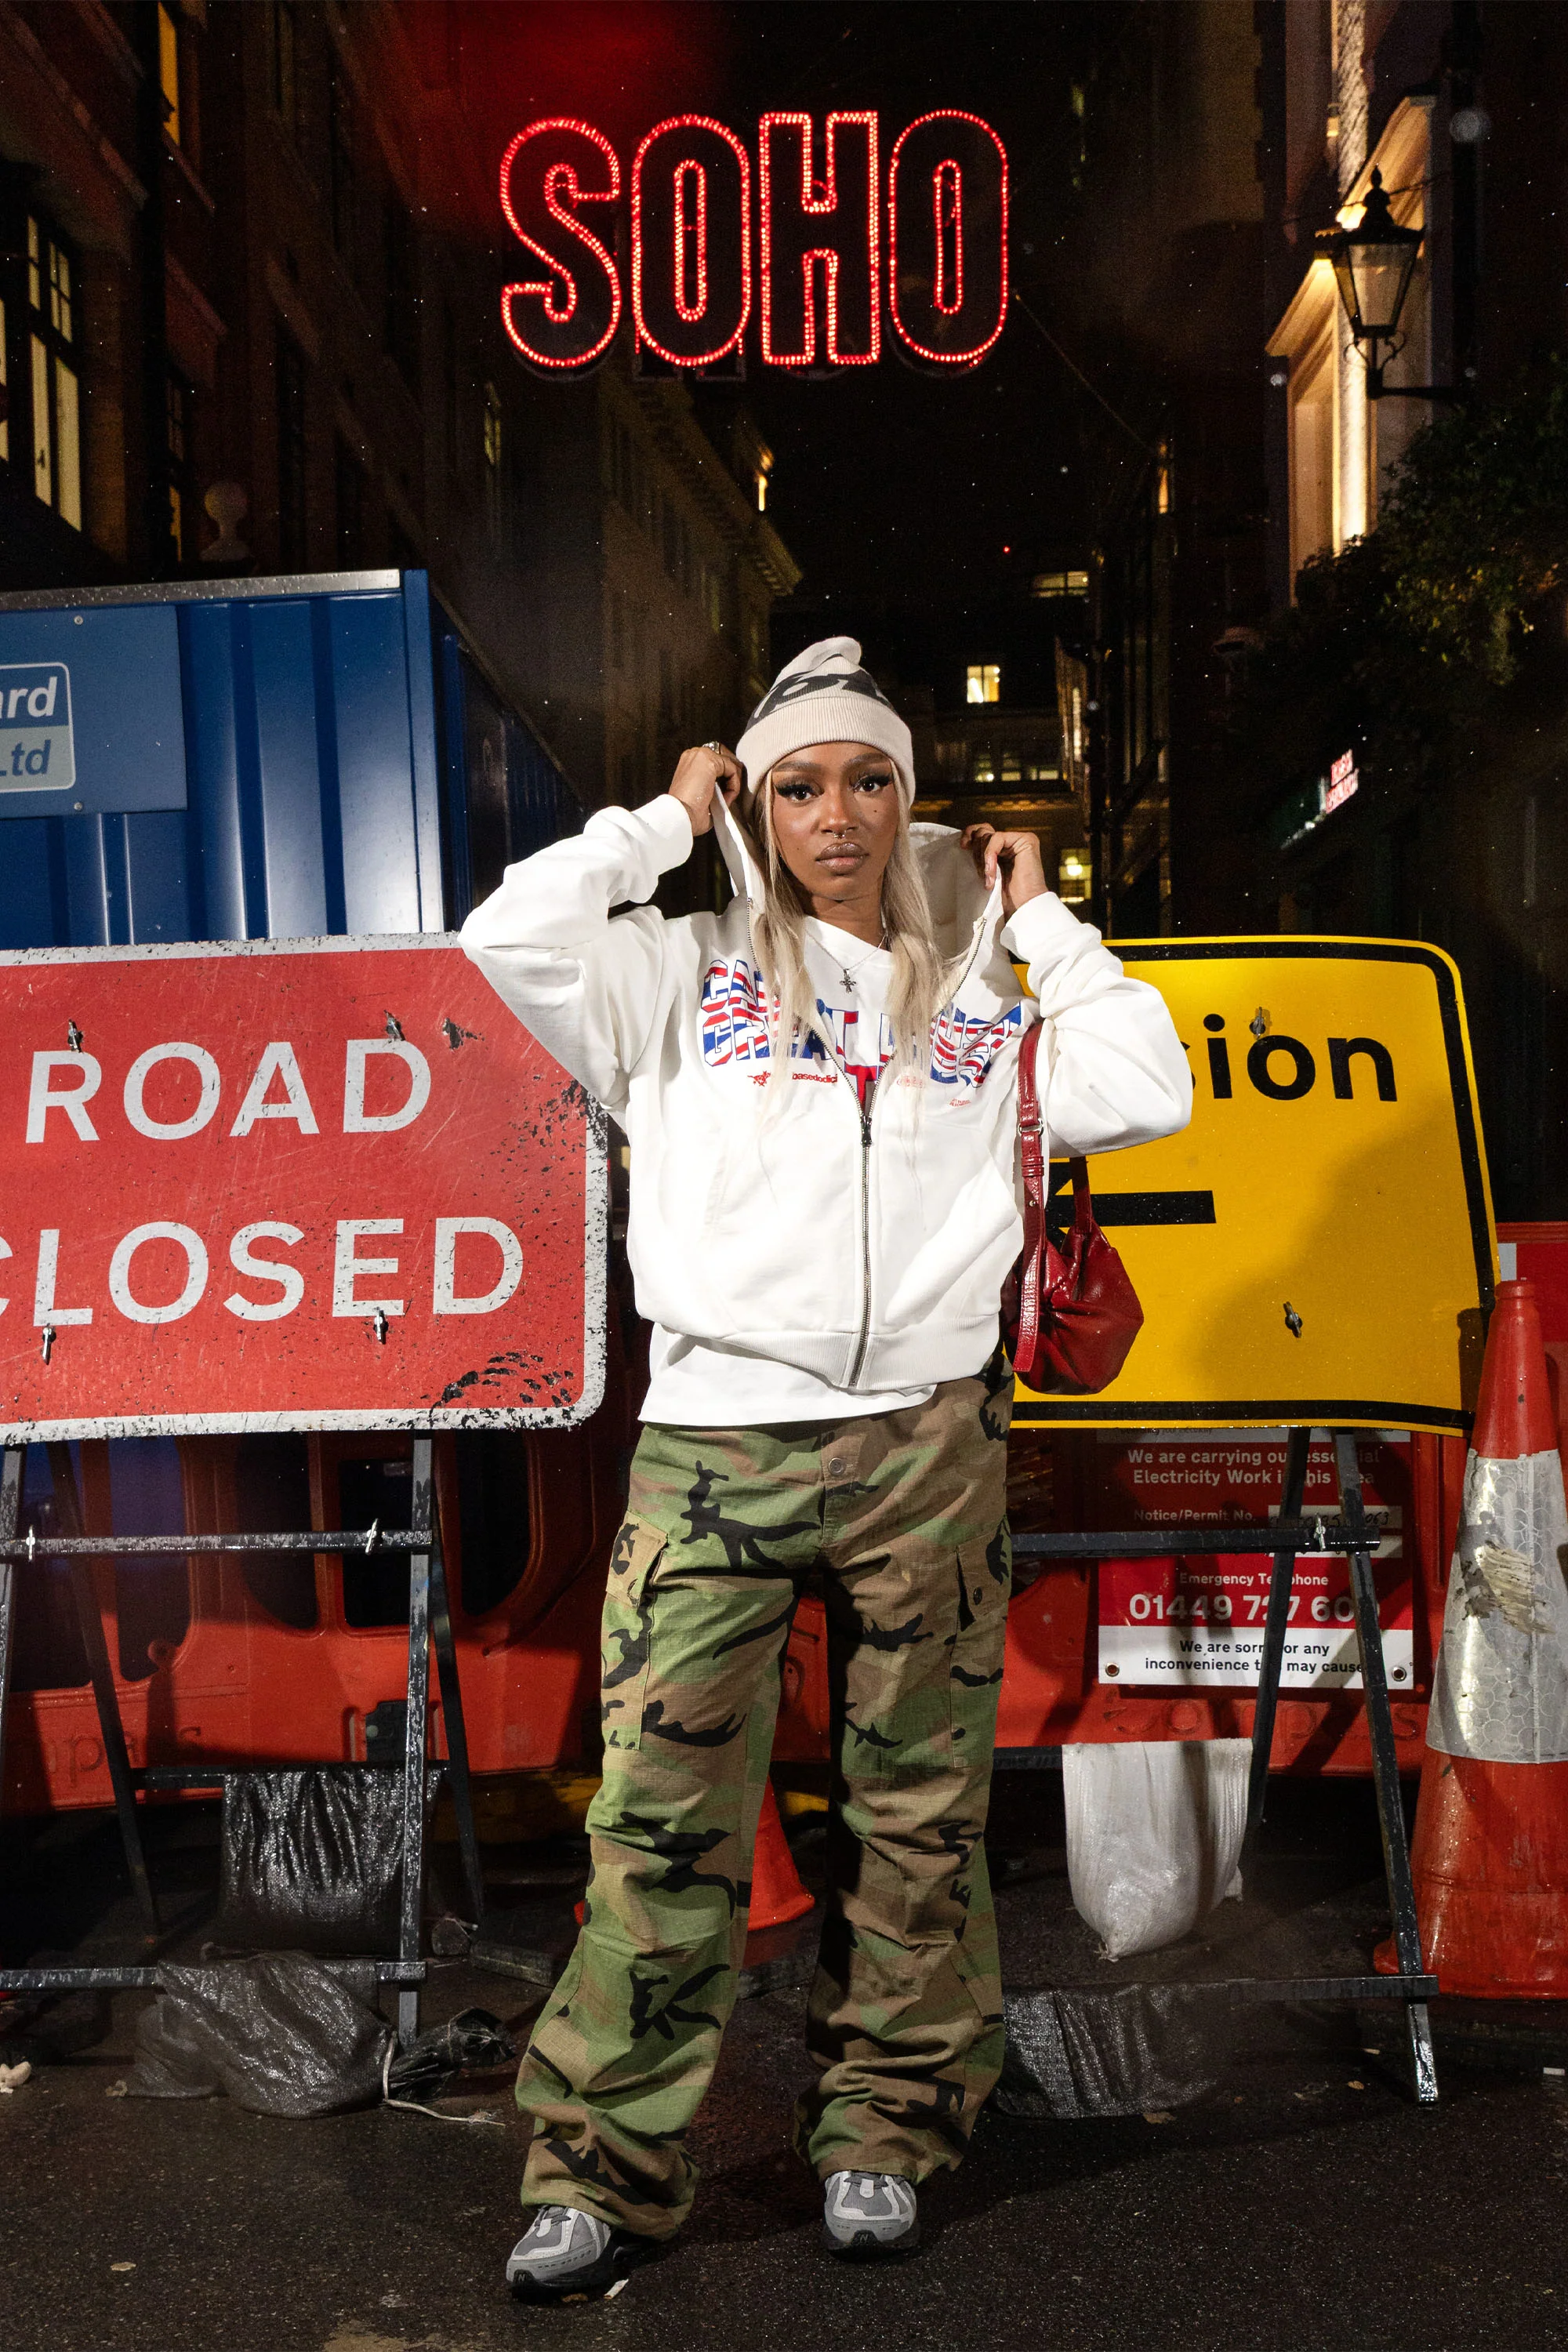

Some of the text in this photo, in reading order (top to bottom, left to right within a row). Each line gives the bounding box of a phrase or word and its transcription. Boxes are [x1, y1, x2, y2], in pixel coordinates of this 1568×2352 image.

[500, 108, 1009, 367] SOHO
[0, 676, 58, 719] rd
[0, 739, 52, 777] td
[1181, 1013, 1398, 1102] ion
[25, 1038, 432, 1144] ROAD
[1127, 1450, 1153, 1464] We
[1159, 1452, 1186, 1464] are
[1191, 1449, 1261, 1466] carrying
[1267, 1452, 1288, 1464] ou
[1134, 1469, 1221, 1486] Electricity
[1226, 1468, 1272, 1484] Work
[1306, 1469, 1331, 1484] his
[1134, 1509, 1229, 1523] Notice/Permit
[1179, 1572, 1254, 1587] Emergency
[1129, 1593, 1233, 1621] 01449
[1311, 1595, 1381, 1623] 60
[1179, 1640, 1330, 1657] We are sorr or any
[1145, 1657, 1250, 1671] inconvenience
[1287, 1662, 1317, 1674] may
